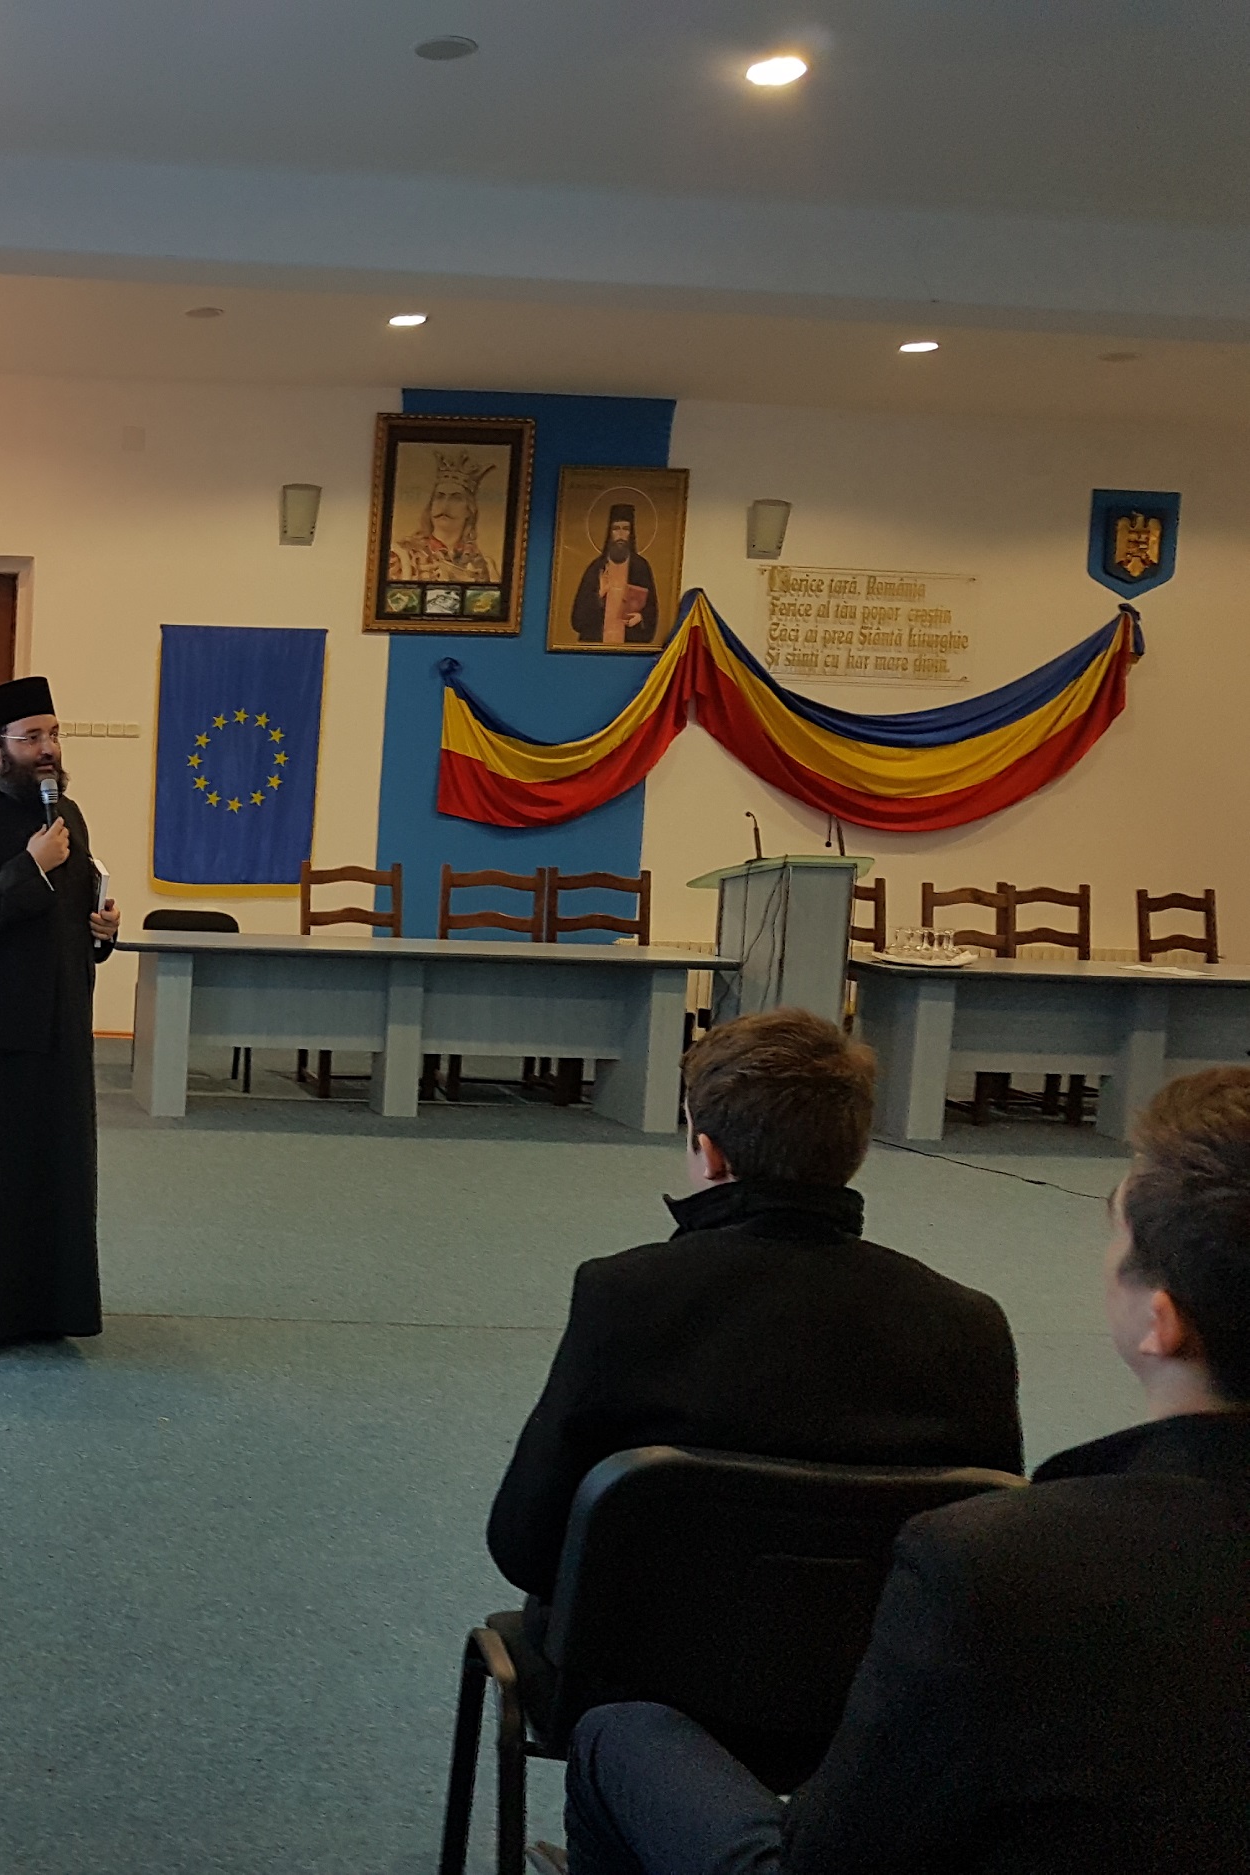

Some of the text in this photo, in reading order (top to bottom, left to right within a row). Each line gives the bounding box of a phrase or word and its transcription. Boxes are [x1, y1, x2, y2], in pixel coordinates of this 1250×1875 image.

[768, 596, 812, 617] Ferice
[816, 599, 830, 618] al
[862, 605, 902, 625] popor
[804, 624, 818, 643] ai
[823, 629, 854, 648] prea
[824, 654, 839, 669] cu
[846, 647, 870, 670] har
[875, 655, 909, 672] mare
